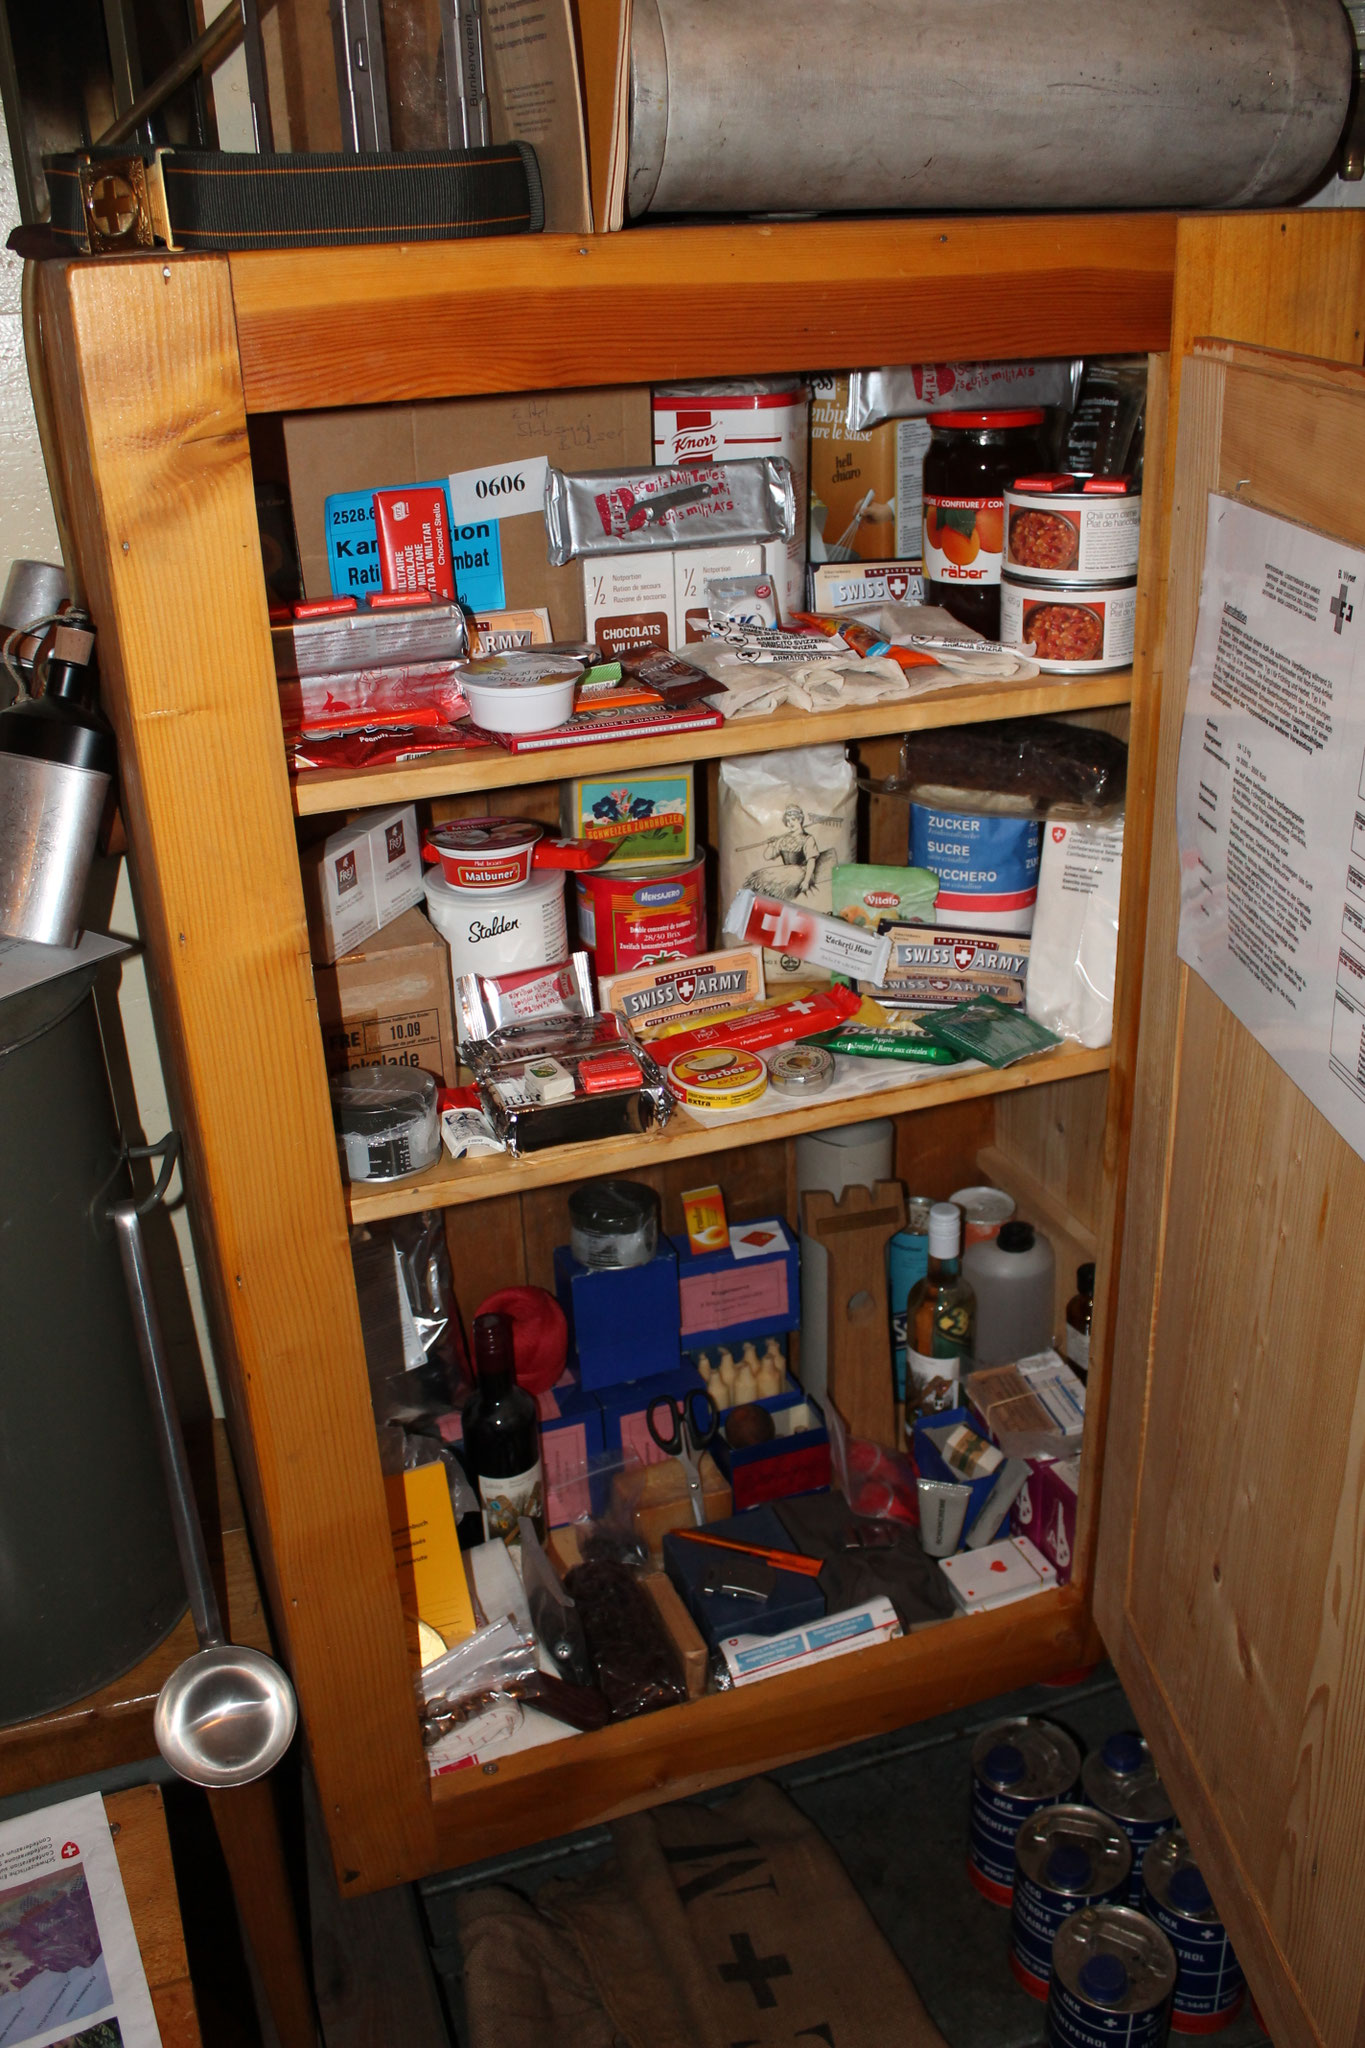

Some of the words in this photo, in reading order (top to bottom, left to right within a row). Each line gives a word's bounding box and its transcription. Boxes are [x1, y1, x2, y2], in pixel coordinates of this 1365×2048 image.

[467, 13, 477, 108] Bunkerverein
[673, 433, 718, 454] Knorr
[475, 472, 527, 499] 0606
[941, 500, 980, 509] CONFITURE
[423, 522, 432, 560] MILITAR
[438, 528, 446, 567] Chocolat
[425, 559, 434, 573] DA
[453, 549, 490, 571] mbat
[395, 551, 405, 590] ILITAIRE
[868, 567, 922, 576] TRADITIONA
[940, 565, 989, 580] räber
[838, 581, 885, 602] SWISS
[602, 624, 661, 641] CHOCOLATS
[472, 634, 527, 654] ARMY
[358, 732, 388, 743] Peanuts
[928, 815, 980, 832] ZUCKER
[389, 832, 403, 851] FREY
[927, 841, 970, 857] SUCRE
[339, 865, 355, 883] FREY
[465, 868, 514, 882] Malbuner
[927, 865, 998, 883] ZUCCHERO
[640, 888, 681, 902] MENSAJERO
[867, 895, 899, 907] Vitalp
[468, 916, 520, 944] Stalden
[904, 947, 951, 964] SWISS
[975, 953, 1026, 973] ARMY
[631, 985, 675, 1013] SWISS
[698, 973, 743, 995] ARMY
[953, 982, 1002, 994] ARMY
[390, 1021, 421, 1041] 10.09
[697, 1065, 746, 1082] Gerber
[687, 1098, 712, 1108] extra
